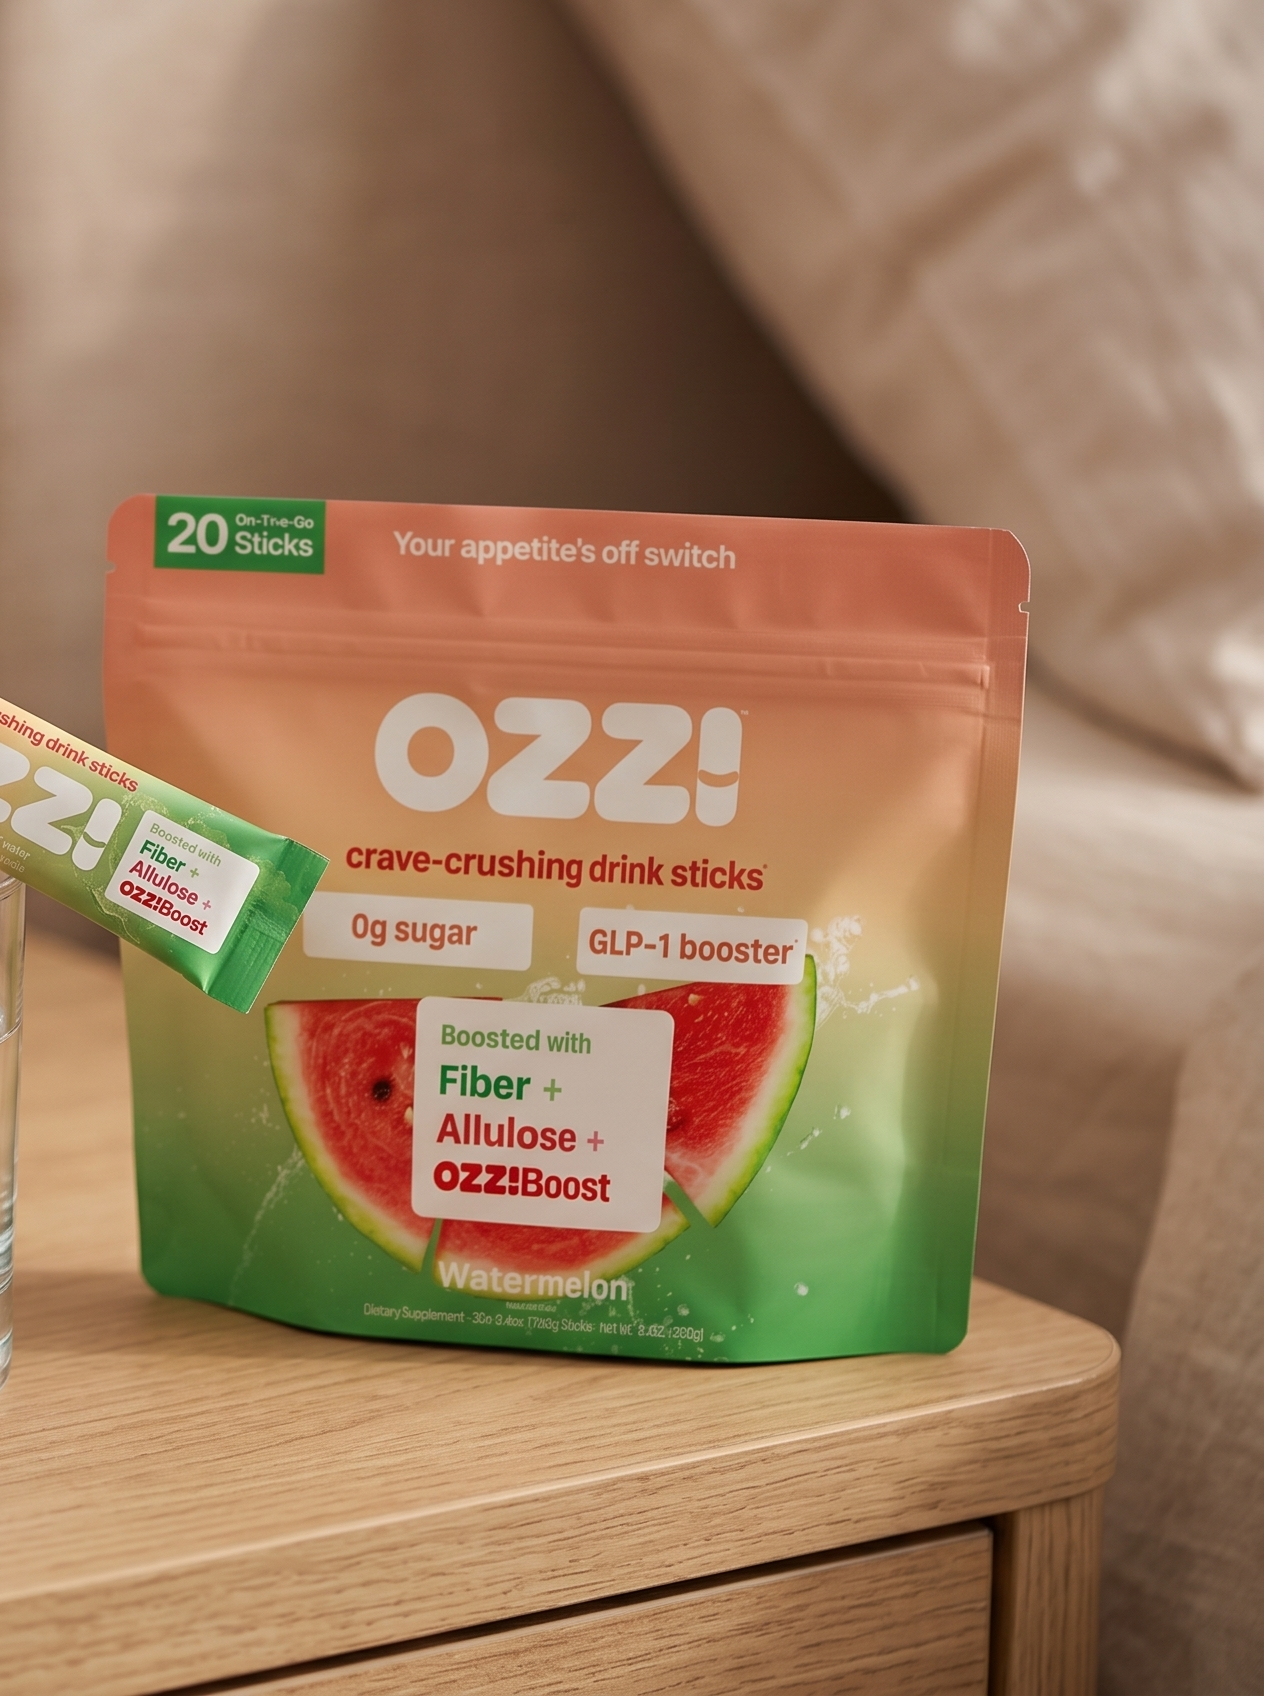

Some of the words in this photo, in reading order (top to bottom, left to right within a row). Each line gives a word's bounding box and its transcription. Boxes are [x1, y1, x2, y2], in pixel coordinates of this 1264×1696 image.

[167, 511, 229, 555] 20
[234, 531, 313, 557] Sticks
[393, 531, 456, 557] Your
[460, 536, 596, 566] appetite's
[602, 540, 640, 565] off
[644, 542, 736, 569] switch
[46, 737, 89, 767] drink
[89, 759, 138, 792] sticks
[139, 839, 186, 872] Fiber
[149, 823, 198, 854] Boosted
[198, 848, 222, 867] with
[129, 860, 199, 905] Allulose
[345, 846, 583, 888] crave-crushing
[589, 854, 664, 886] drink
[351, 912, 387, 946] 0g
[394, 918, 478, 951] sugar
[589, 928, 670, 959] GLP-1
[441, 1024, 541, 1051] Boosted
[547, 1031, 592, 1054] with
[439, 1064, 532, 1100] Fiber
[436, 1113, 577, 1152] Allulose
[438, 1260, 627, 1301] Watermelon
[363, 1303, 401, 1320] Dietary
[402, 1306, 465, 1322] Supplement
